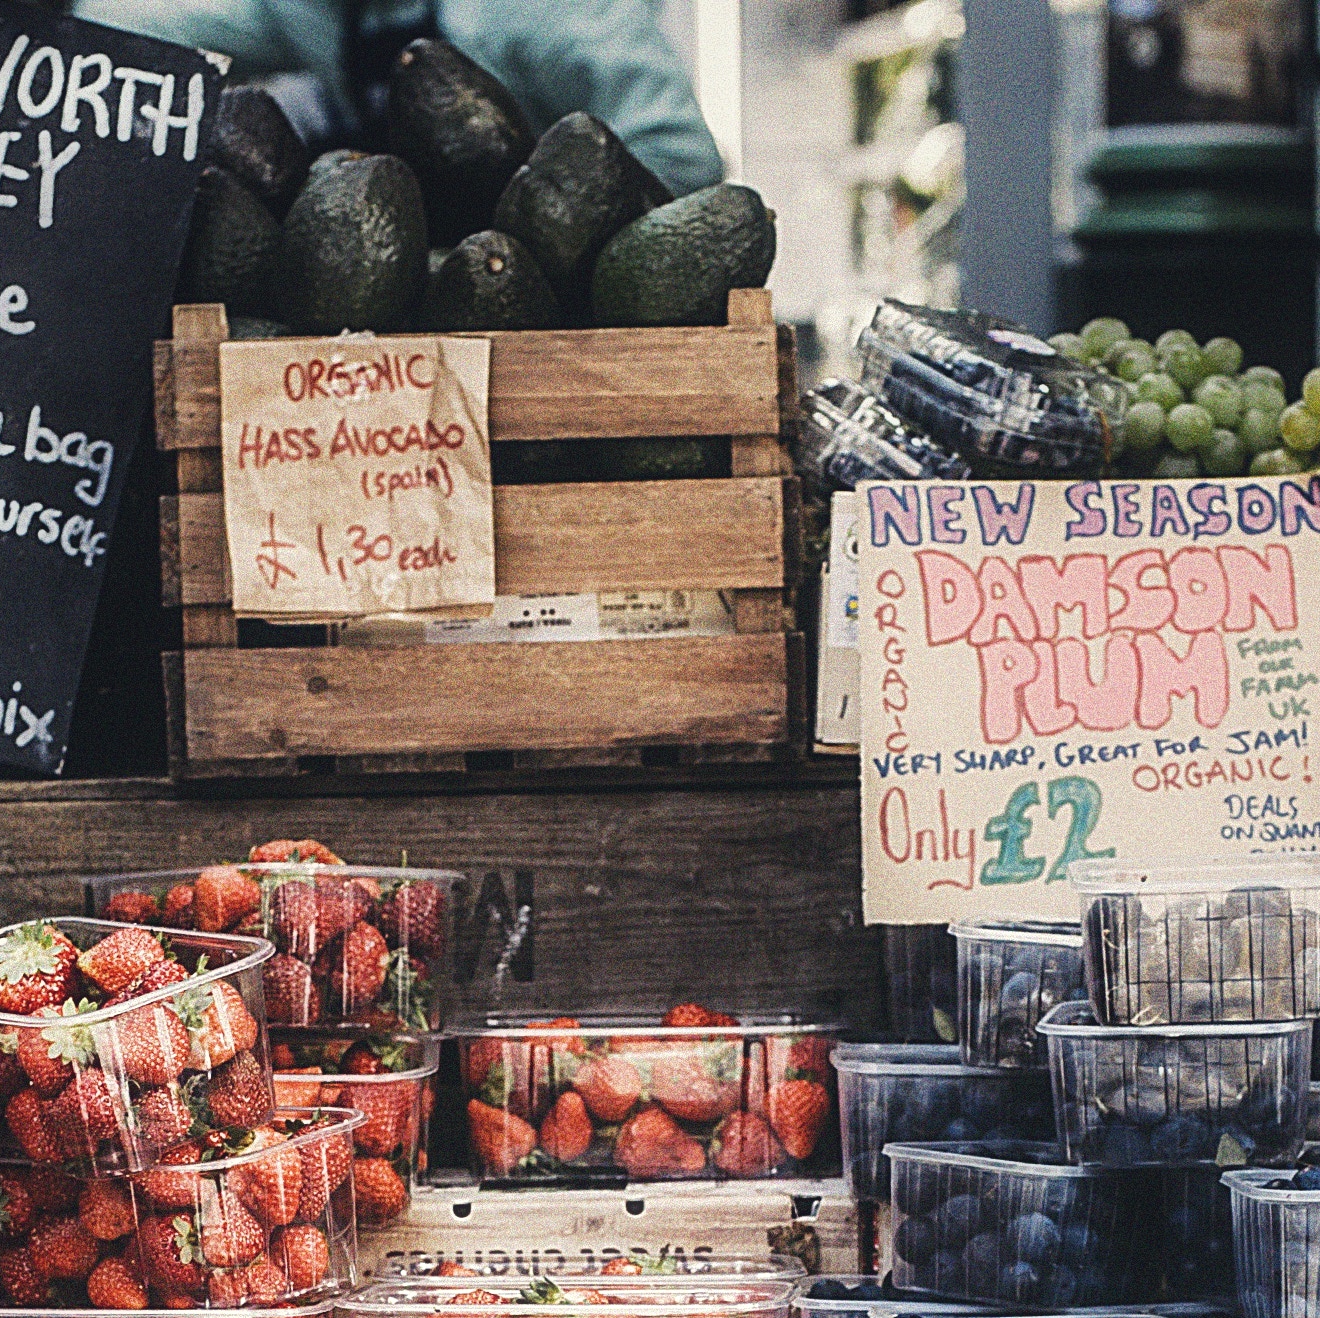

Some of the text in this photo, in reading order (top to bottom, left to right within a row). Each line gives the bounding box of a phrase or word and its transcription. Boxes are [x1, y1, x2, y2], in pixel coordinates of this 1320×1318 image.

[284, 353, 435, 401] ORGANIC
[24, 405, 114, 507] bag
[238, 418, 465, 470] HASS AVOCADO
[867, 483, 1036, 548] NEW
[915, 545, 1300, 647] DAMSON
[874, 570, 910, 754] ORGANIC
[1237, 638, 1303, 660] FROM
[978, 630, 1231, 745] PLUM
[1268, 696, 1310, 720] UK
[873, 752, 942, 779] VERY
[1054, 741, 1142, 769] GREAT
[1155, 735, 1210, 760] FOR
[1225, 720, 1309, 755] JAM!
[878, 775, 1117, 892] Only £2
[1221, 822, 1254, 840] ON
[1224, 794, 1299, 820] DEALS
